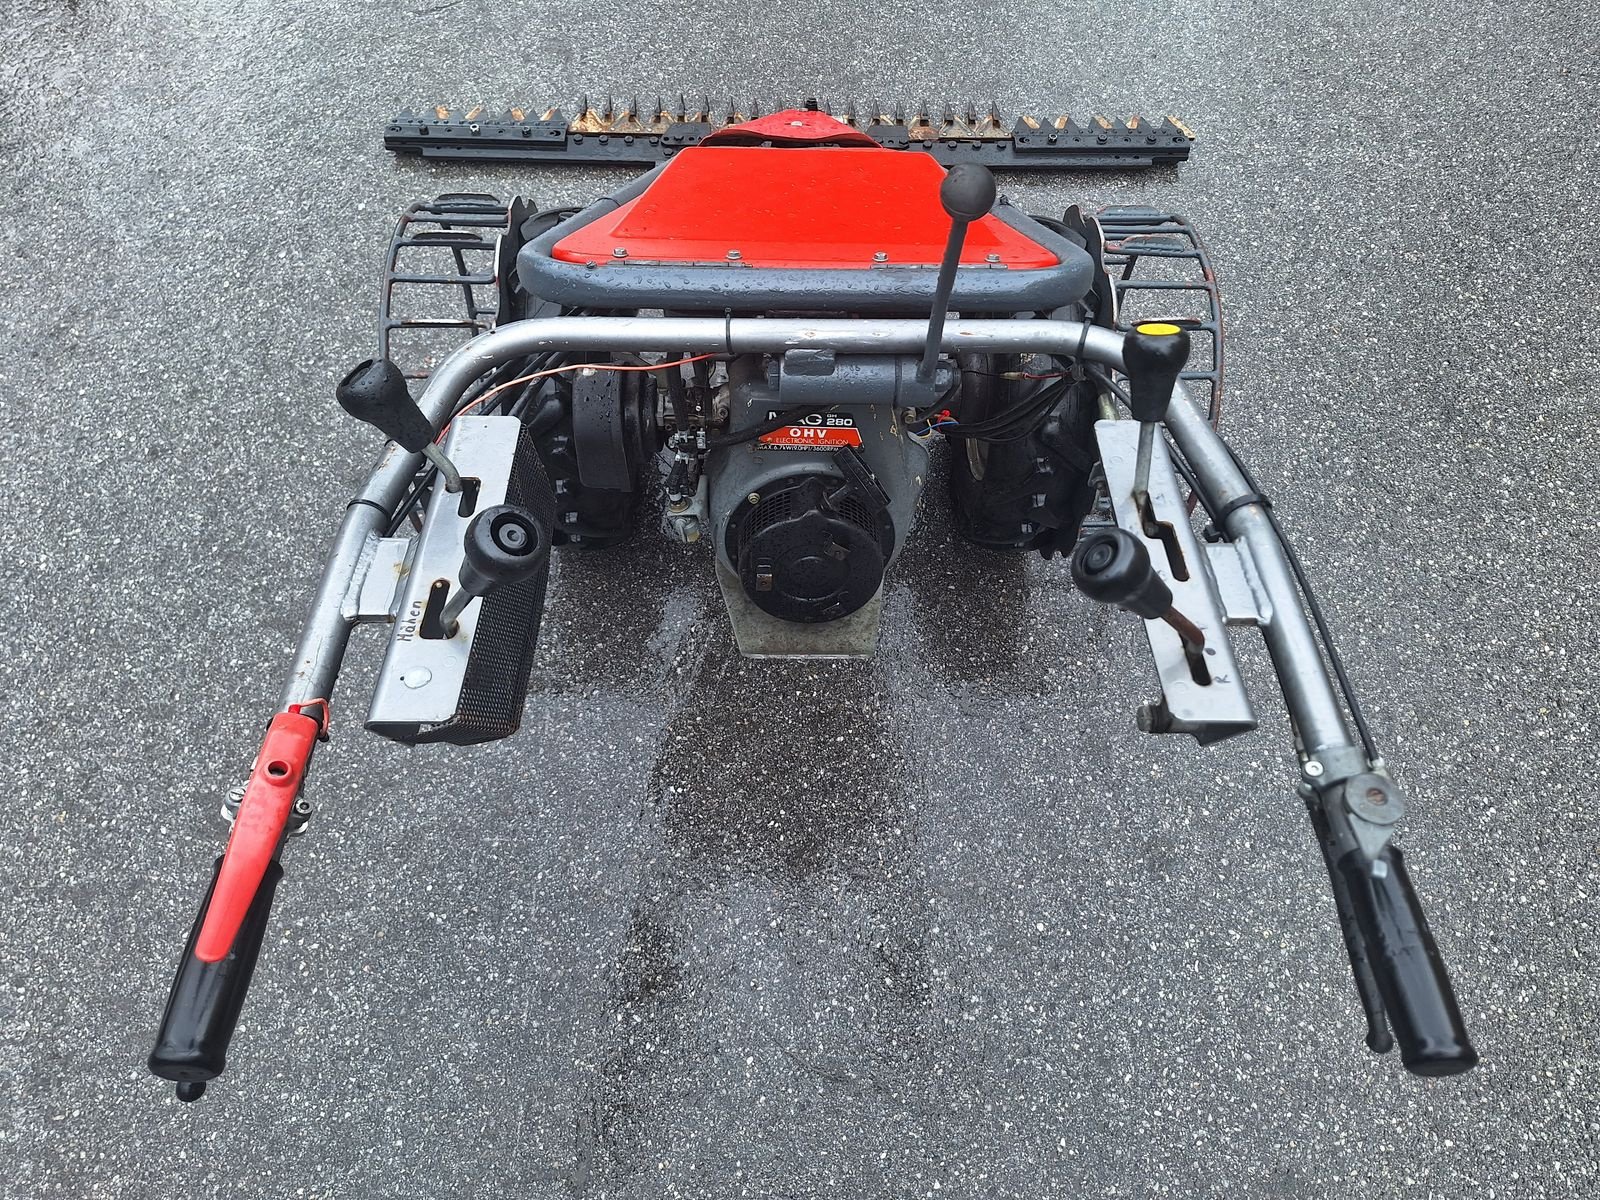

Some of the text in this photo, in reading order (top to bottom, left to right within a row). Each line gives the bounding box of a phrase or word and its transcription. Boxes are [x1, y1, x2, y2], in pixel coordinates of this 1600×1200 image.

[826, 418, 853, 426] 280
[789, 428, 828, 438] OHV
[775, 437, 815, 445] ELECTRONIC
